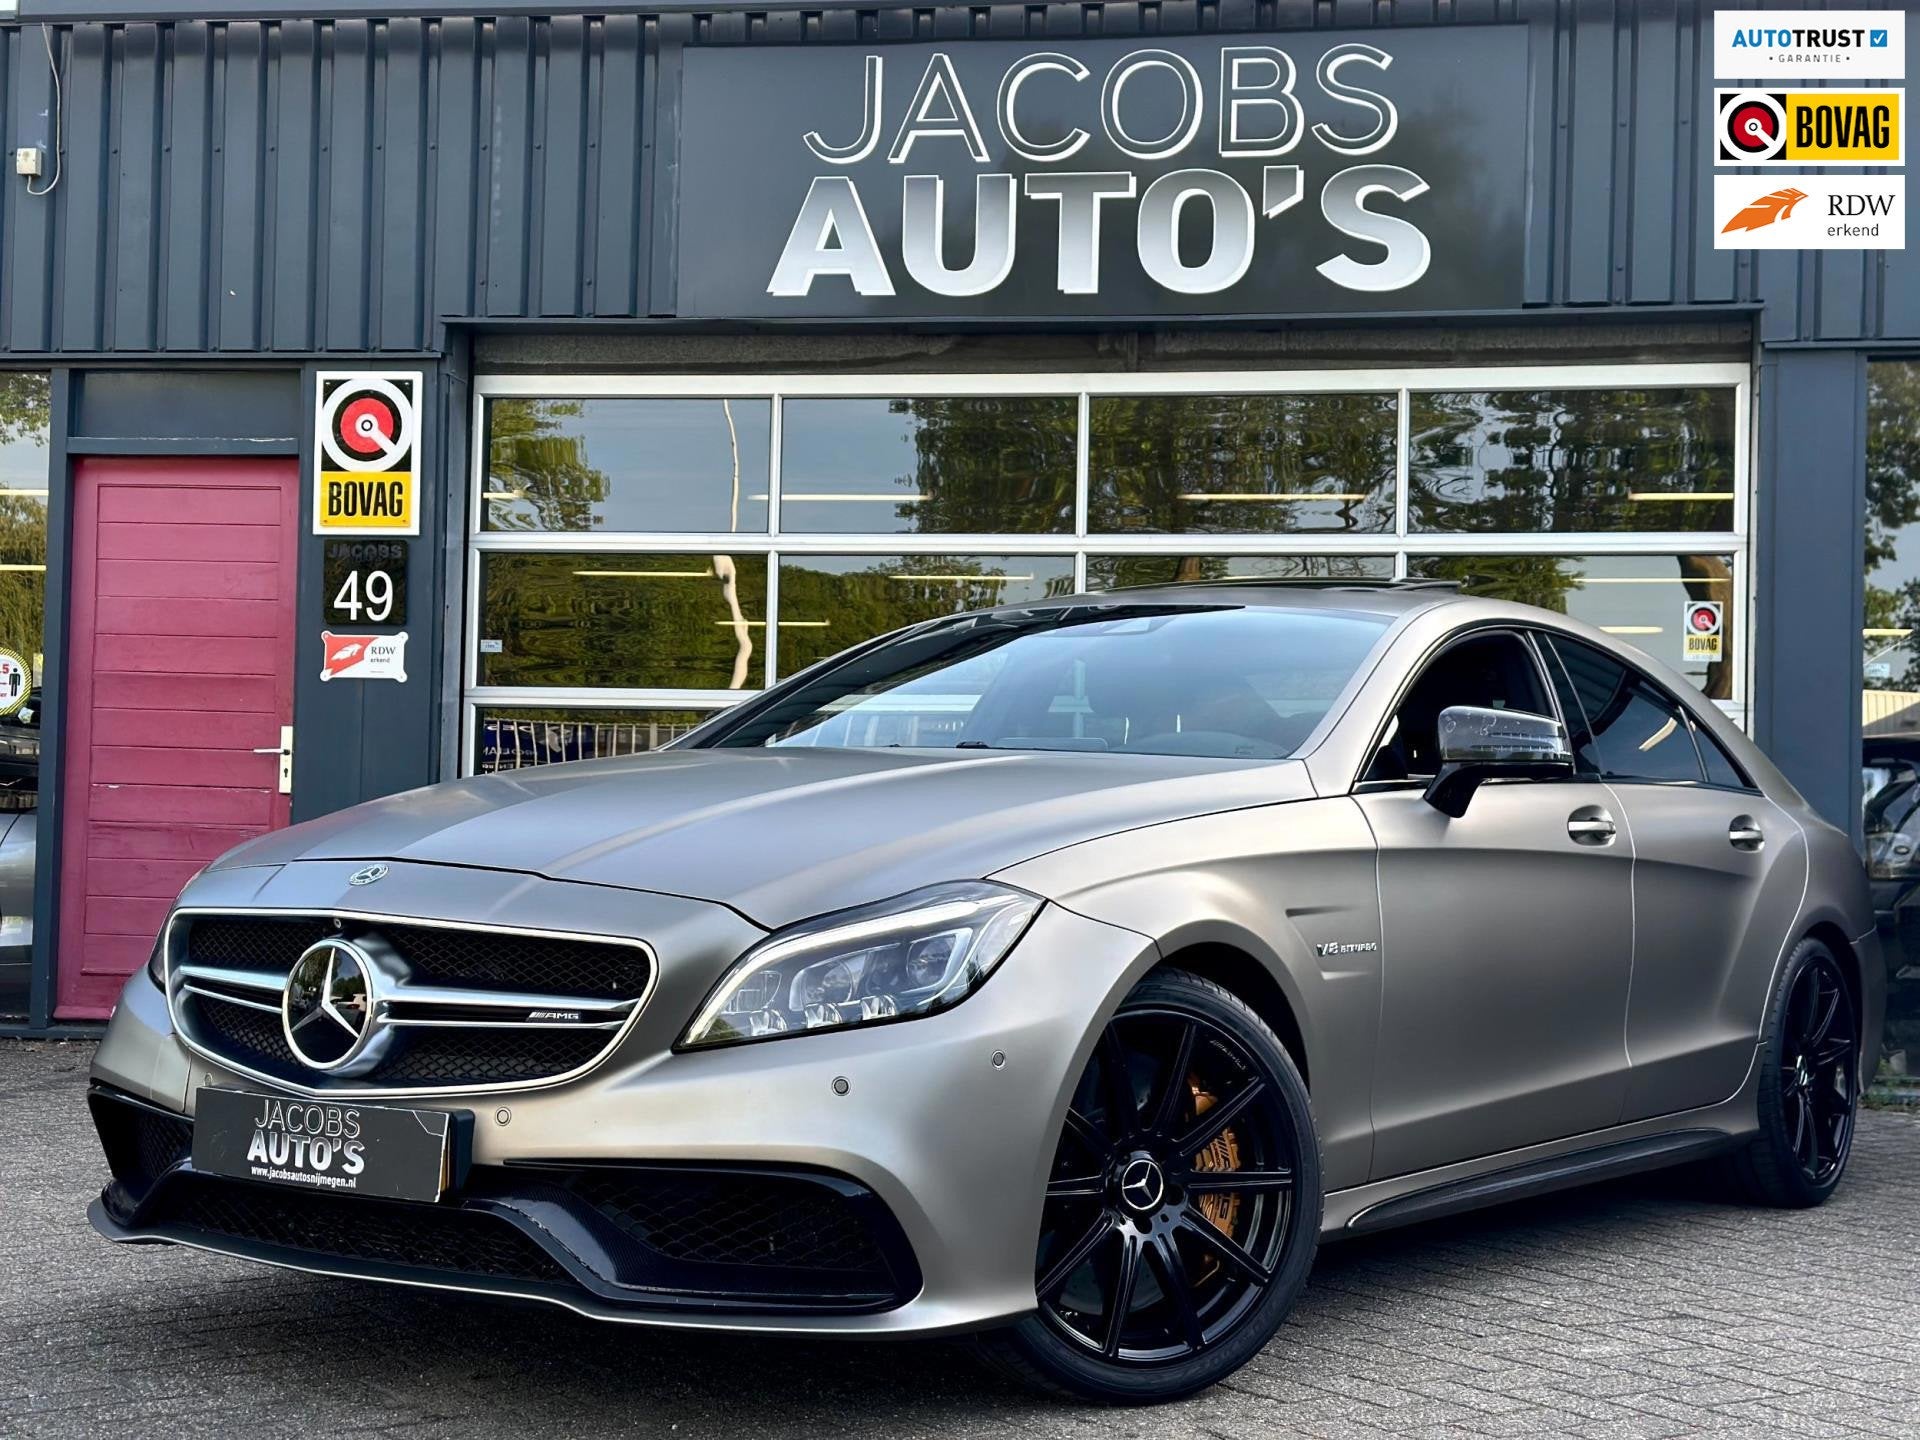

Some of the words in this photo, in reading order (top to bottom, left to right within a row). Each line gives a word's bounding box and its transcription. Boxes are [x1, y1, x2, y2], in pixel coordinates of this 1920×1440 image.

[803, 44, 1399, 164] JACOBS
[767, 165, 1431, 297] AUTO'S
[328, 481, 403, 517] BOVAG
[333, 570, 394, 622] 49
[370, 646, 397, 655] RDW
[1689, 638, 1717, 650] BOVAG
[1316, 942, 1338, 956] V8
[254, 1099, 360, 1139] JACOBS
[246, 1129, 365, 1175] AUTO'S
[251, 1166, 357, 1188] www.jacobsautosnijmegen.nl
